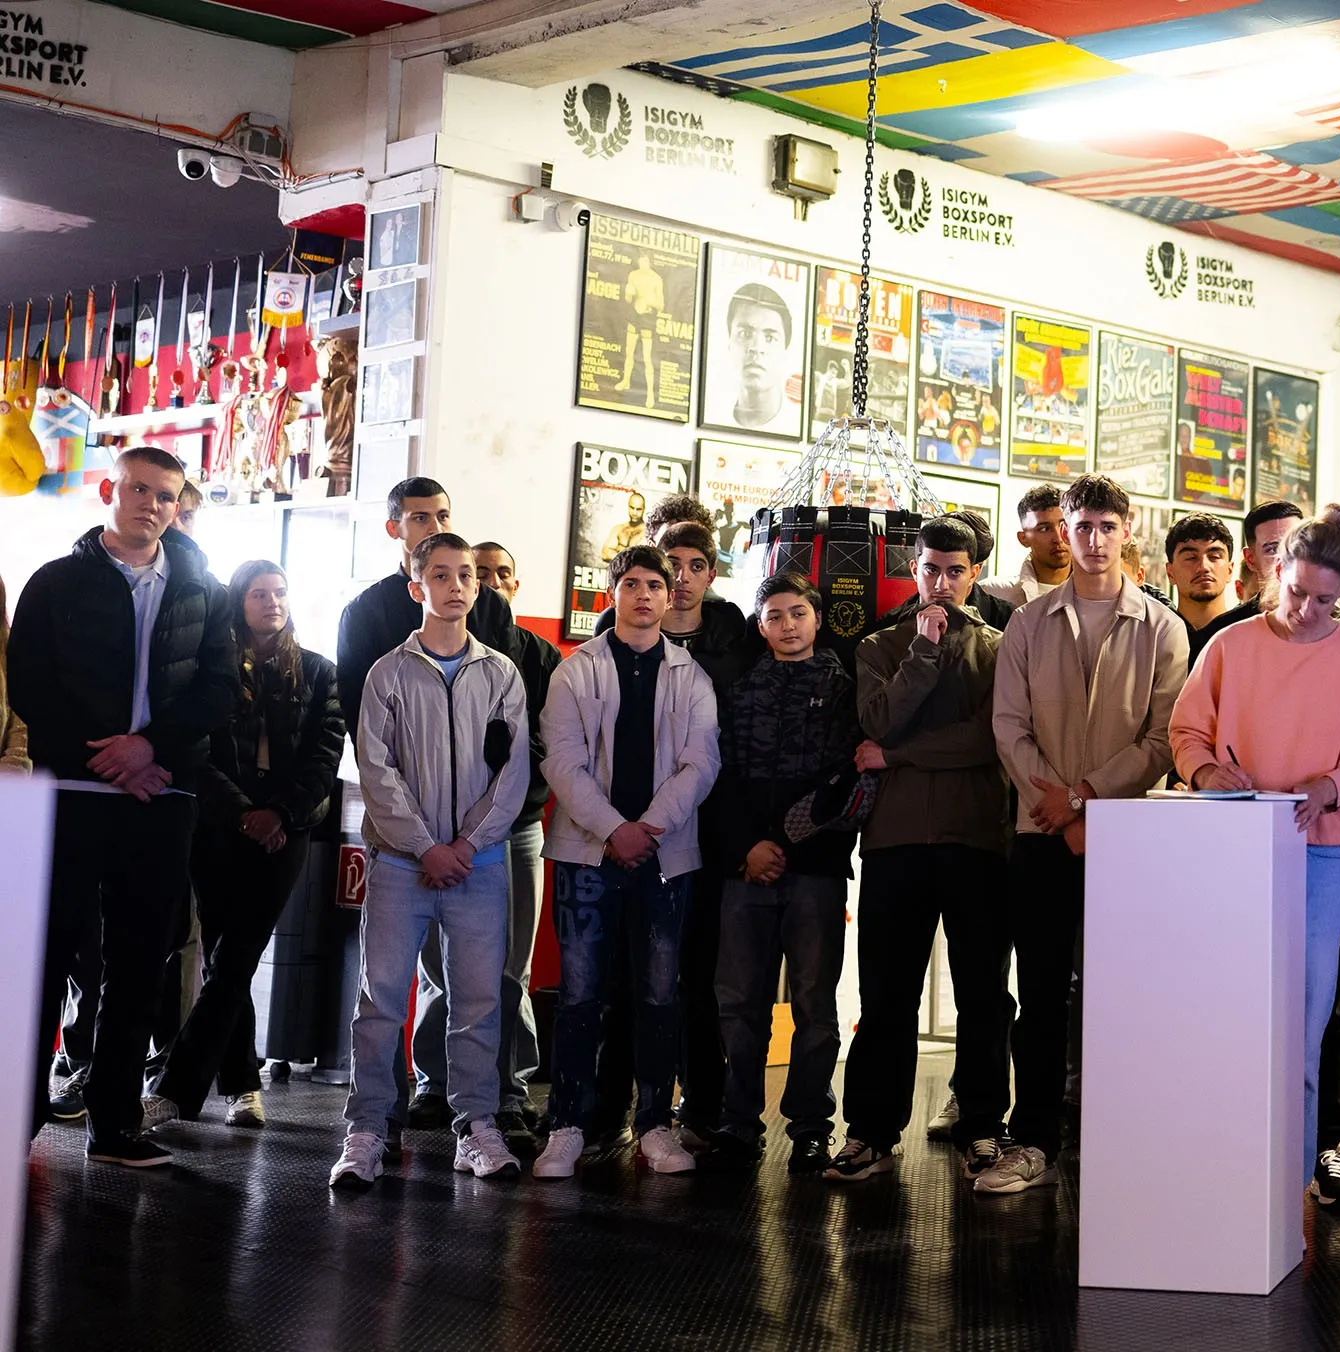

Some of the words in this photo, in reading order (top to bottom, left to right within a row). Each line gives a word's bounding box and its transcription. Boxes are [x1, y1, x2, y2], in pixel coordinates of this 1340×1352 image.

[50, 64, 87, 87] E.V.
[645, 106, 704, 130] ISIGYM
[645, 125, 735, 155] BOXSPORT
[645, 147, 706, 167] BERLIN
[942, 187, 988, 208] ISIGYM
[942, 205, 1013, 230] BOXSPORT
[943, 223, 990, 242] BERLIN
[994, 231, 1015, 247] E.V.
[768, 260, 800, 283] ALI
[1196, 255, 1233, 273] ISIGYM
[1197, 272, 1254, 293] BOXSPORT
[1197, 288, 1235, 305] BERLIN
[581, 447, 688, 495] BOXEN
[706, 481, 740, 492] YOUTH
